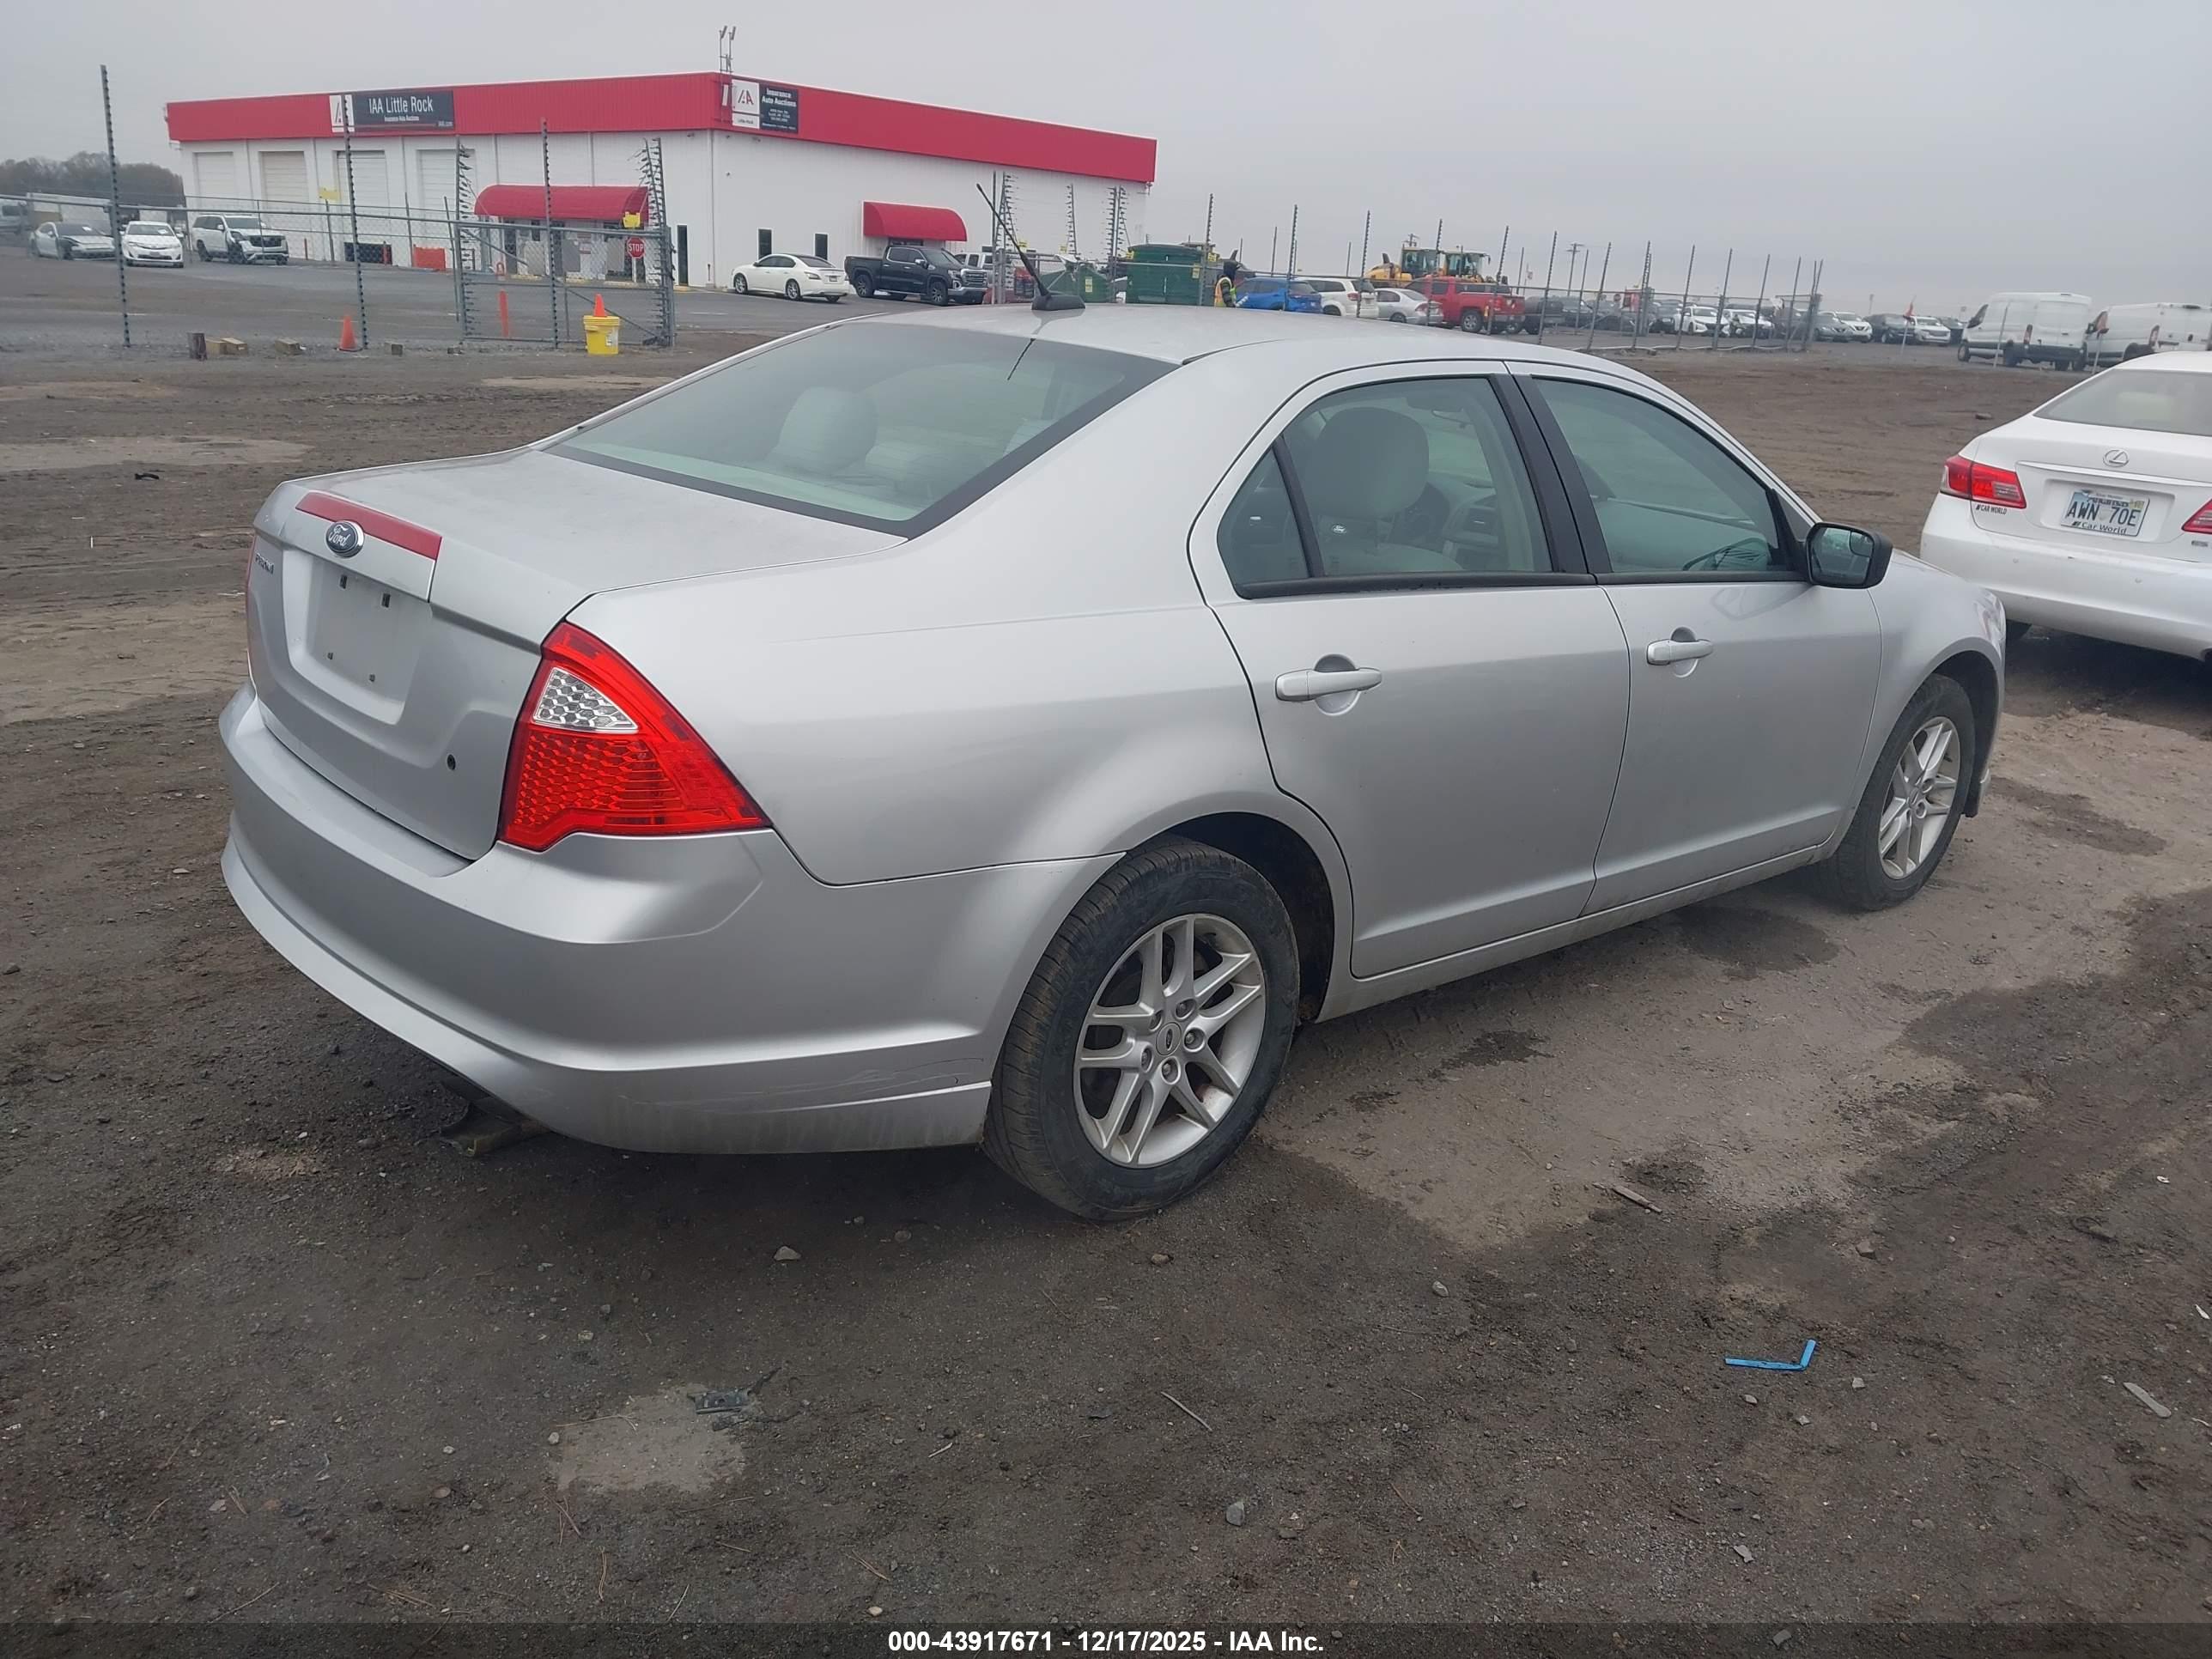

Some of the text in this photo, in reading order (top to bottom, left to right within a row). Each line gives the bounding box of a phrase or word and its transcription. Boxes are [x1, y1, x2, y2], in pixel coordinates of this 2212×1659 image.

[369, 98, 384, 114] IAA
[386, 96, 408, 113] Little
[410, 95, 434, 112] Rock
[628, 243, 644, 252] STOP
[1980, 504, 2008, 515] CAR WORLD
[2064, 501, 2142, 527] AWN 70E
[328, 524, 351, 547] Ford
[2081, 521, 2128, 537] Car World
